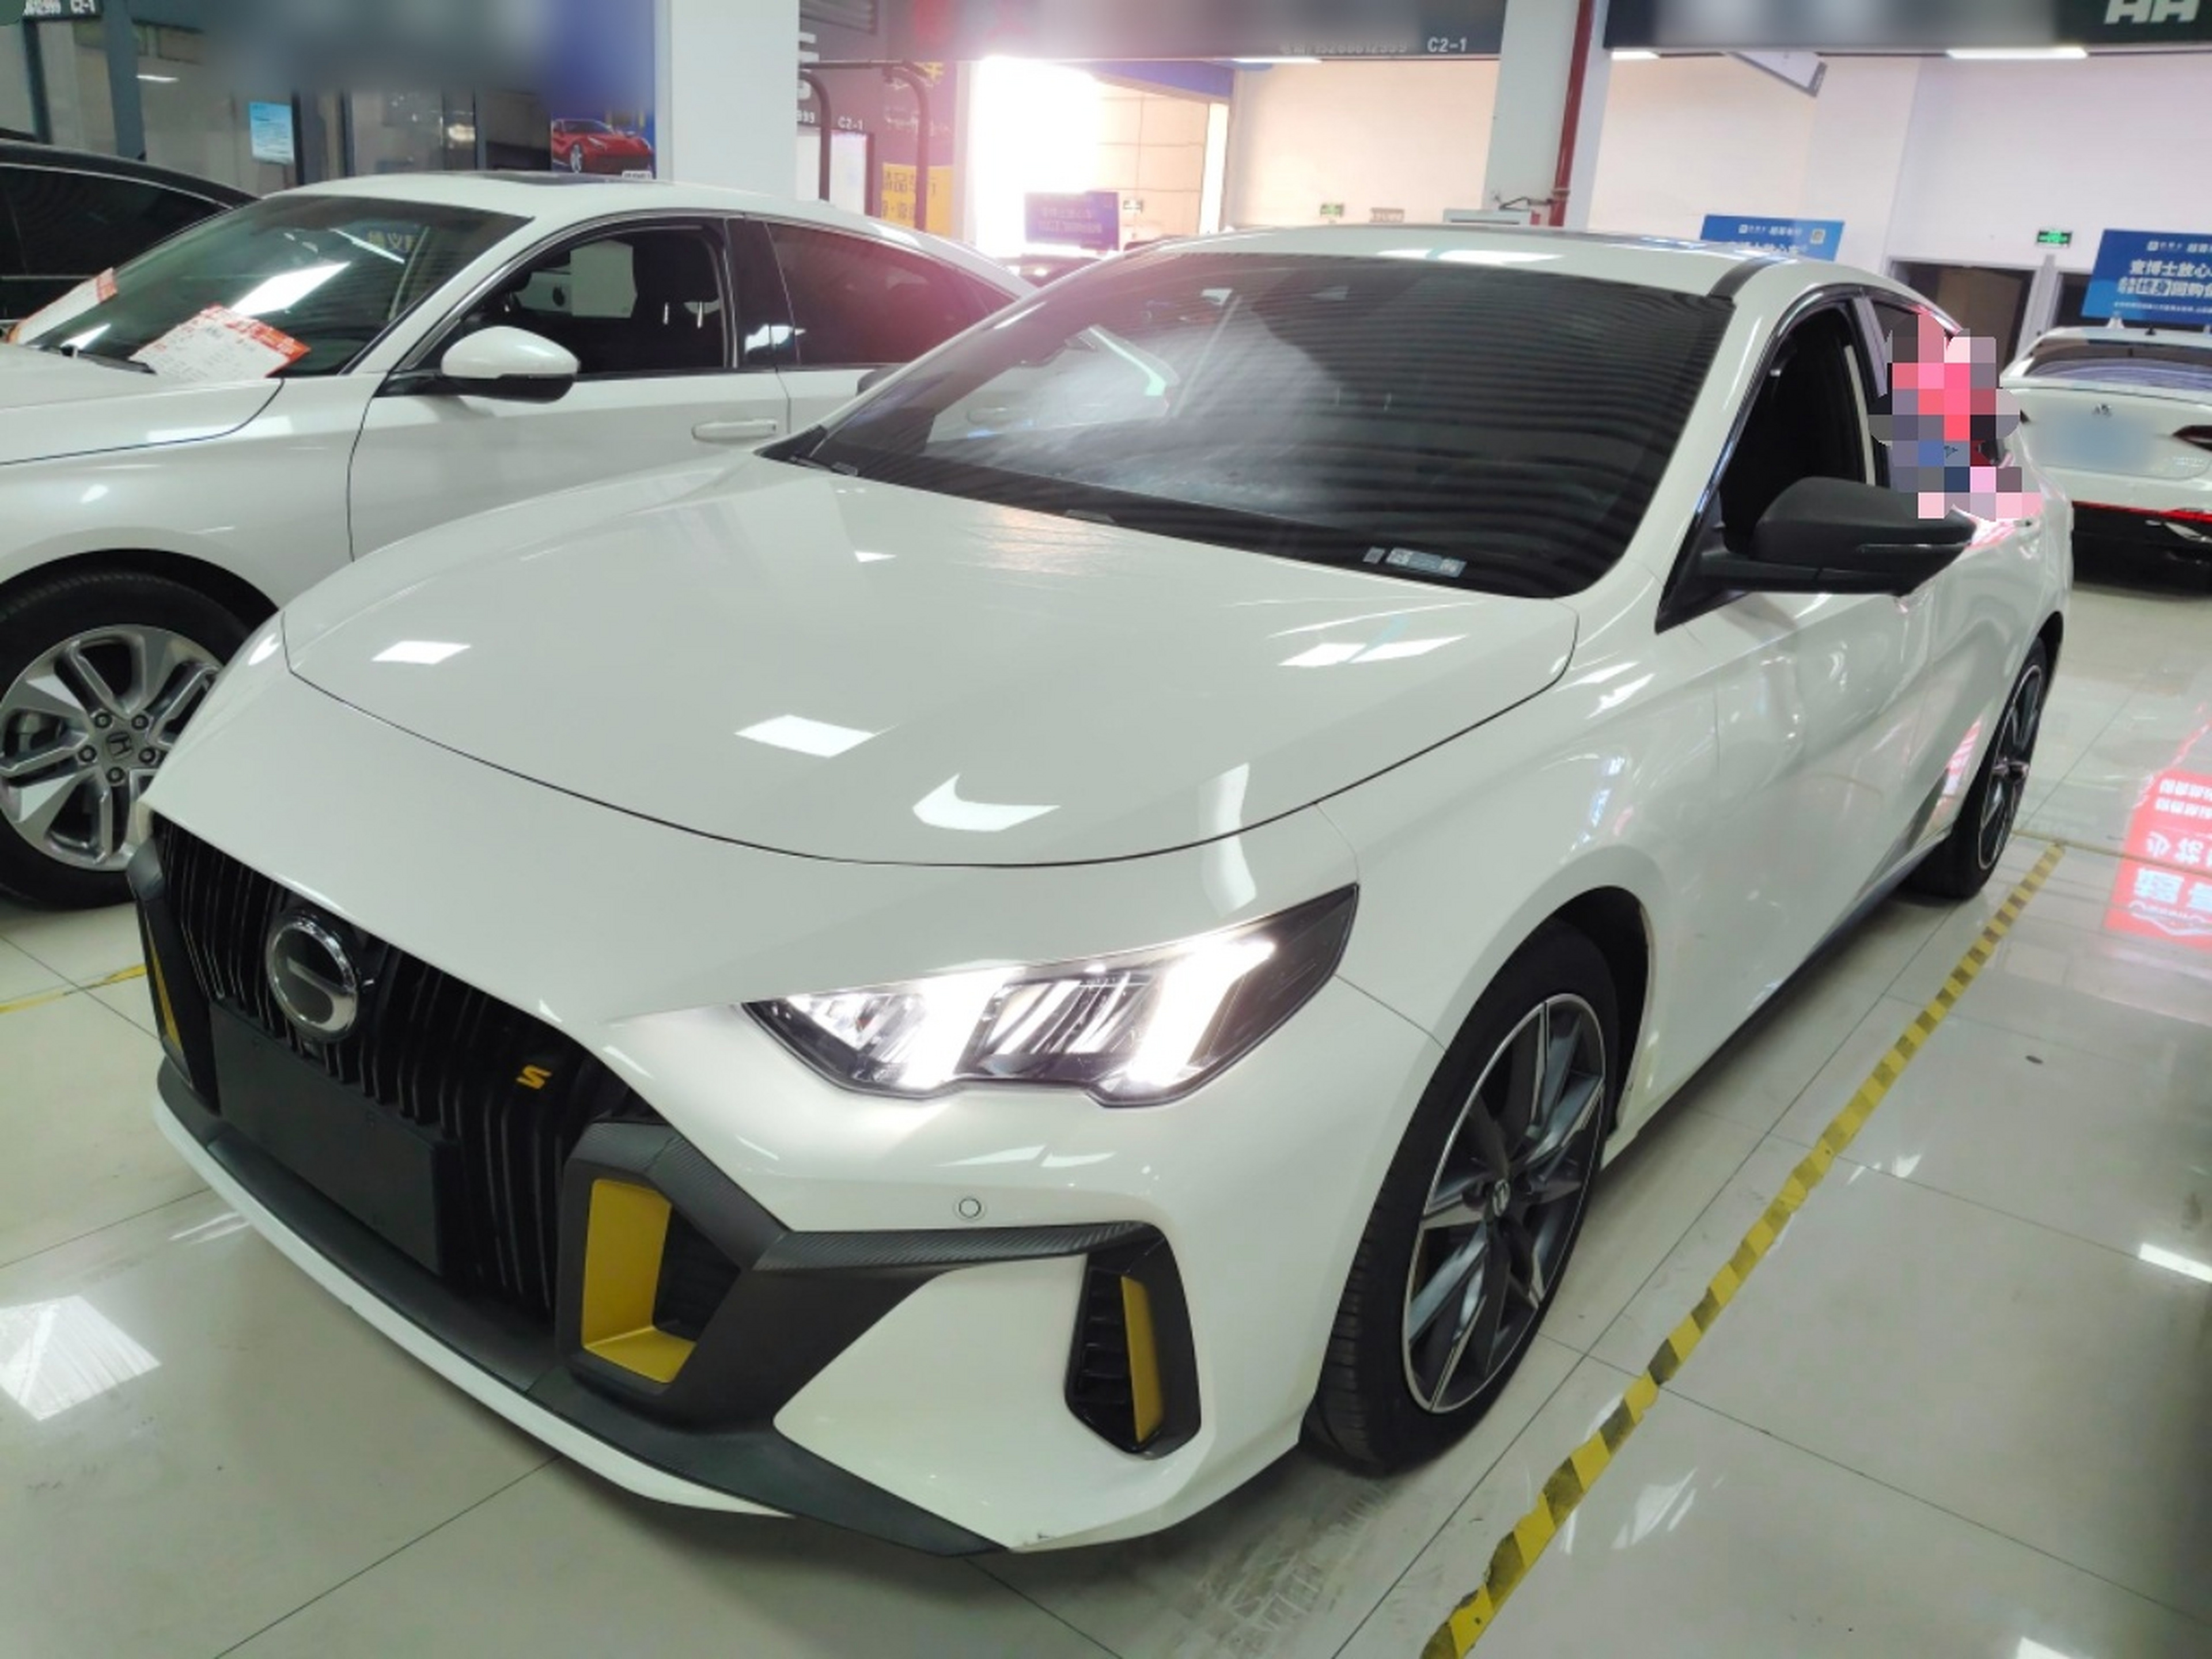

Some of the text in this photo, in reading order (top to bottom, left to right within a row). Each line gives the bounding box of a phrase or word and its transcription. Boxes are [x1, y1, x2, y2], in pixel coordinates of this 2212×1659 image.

[1427, 37, 1468, 52] C2-1
[838, 116, 863, 131] C2-1
[2129, 259, 2212, 279] 查博士放心
[516, 1064, 552, 1089] S
